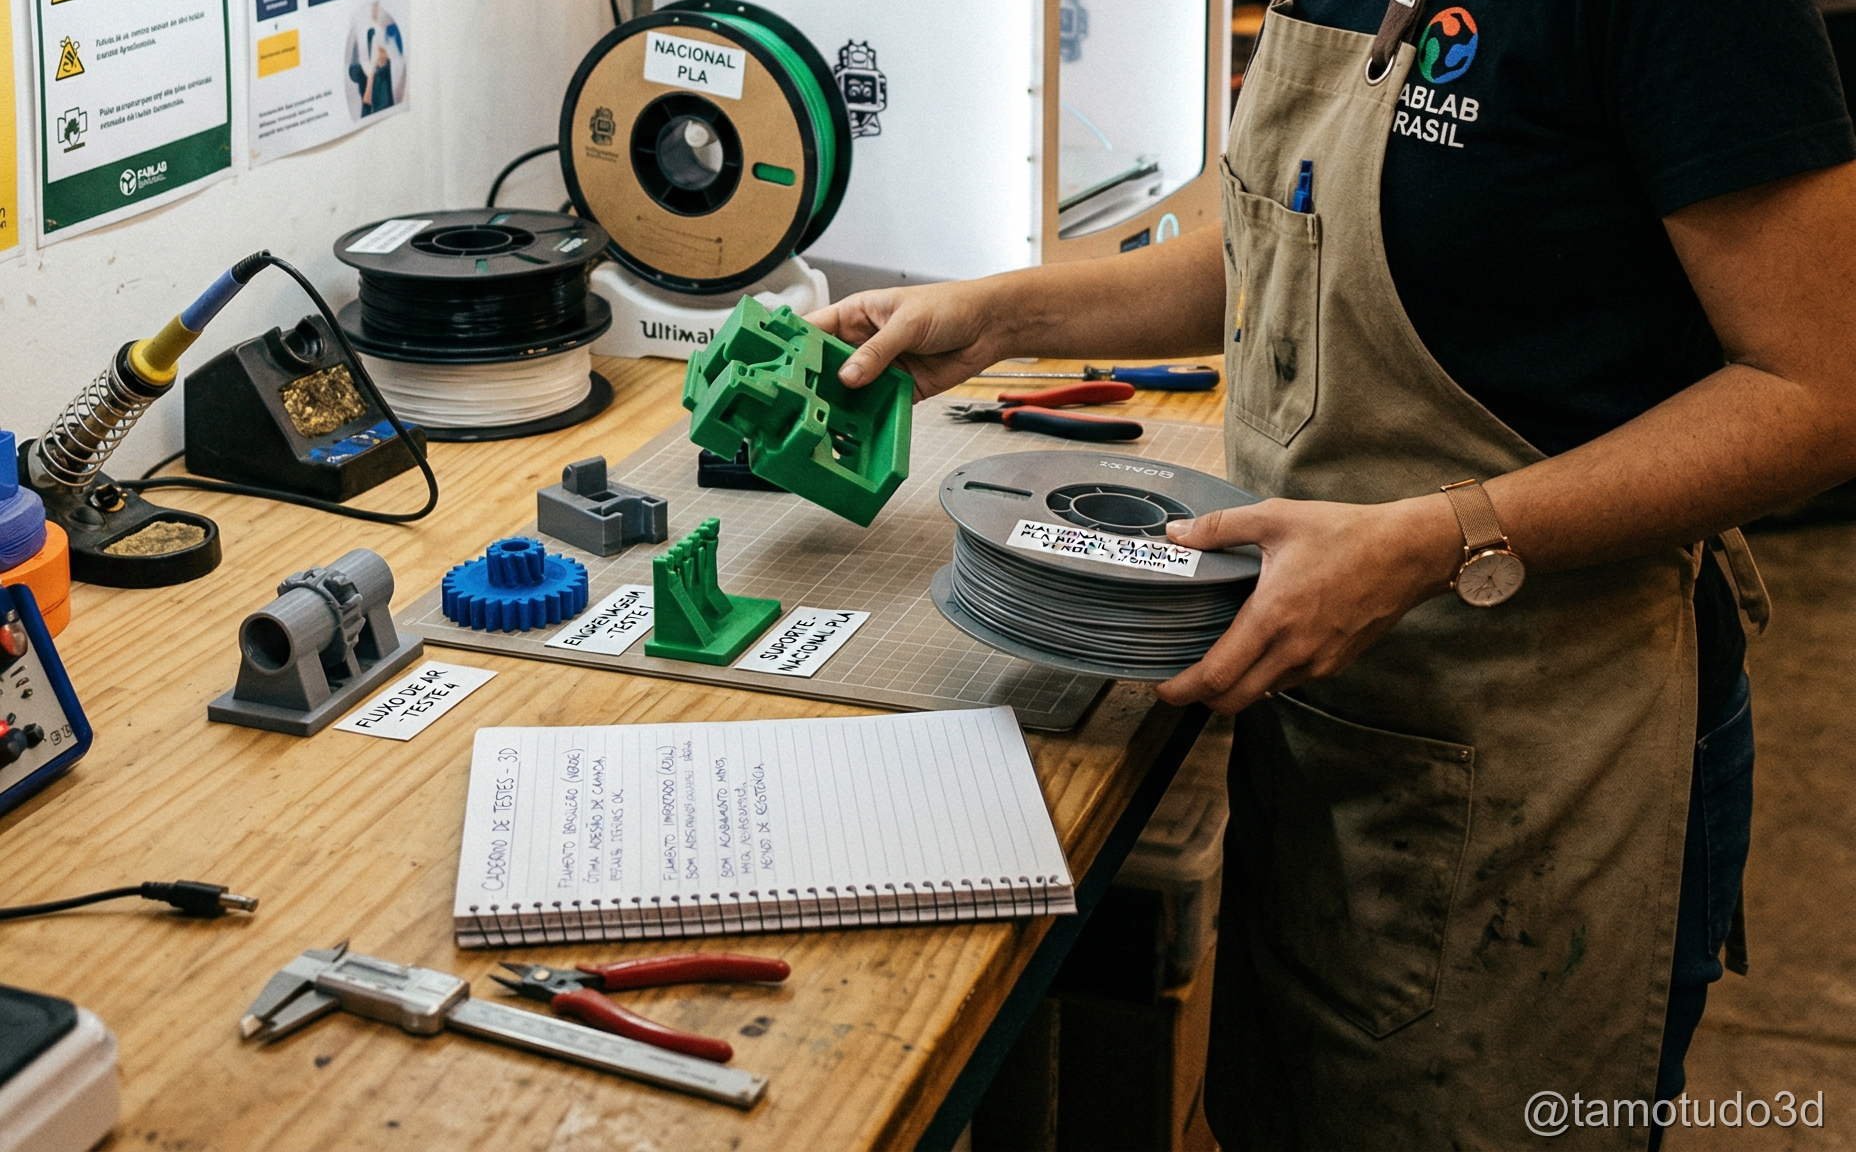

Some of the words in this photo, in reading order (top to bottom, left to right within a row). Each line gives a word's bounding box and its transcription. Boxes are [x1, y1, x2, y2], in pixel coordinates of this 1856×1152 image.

[654, 39, 736, 69] NACIONAL
[677, 65, 708, 84] PLA
[1397, 82, 1480, 123] ABLAB
[1392, 110, 1465, 149] RASIL
[825, 612, 855, 629] PLA
[355, 697, 406, 728] FLUXO
[398, 683, 426, 696] DE
[419, 669, 448, 684] AR
[498, 747, 518, 762] 3D
[493, 778, 515, 814] TESTES
[491, 819, 511, 832] DE
